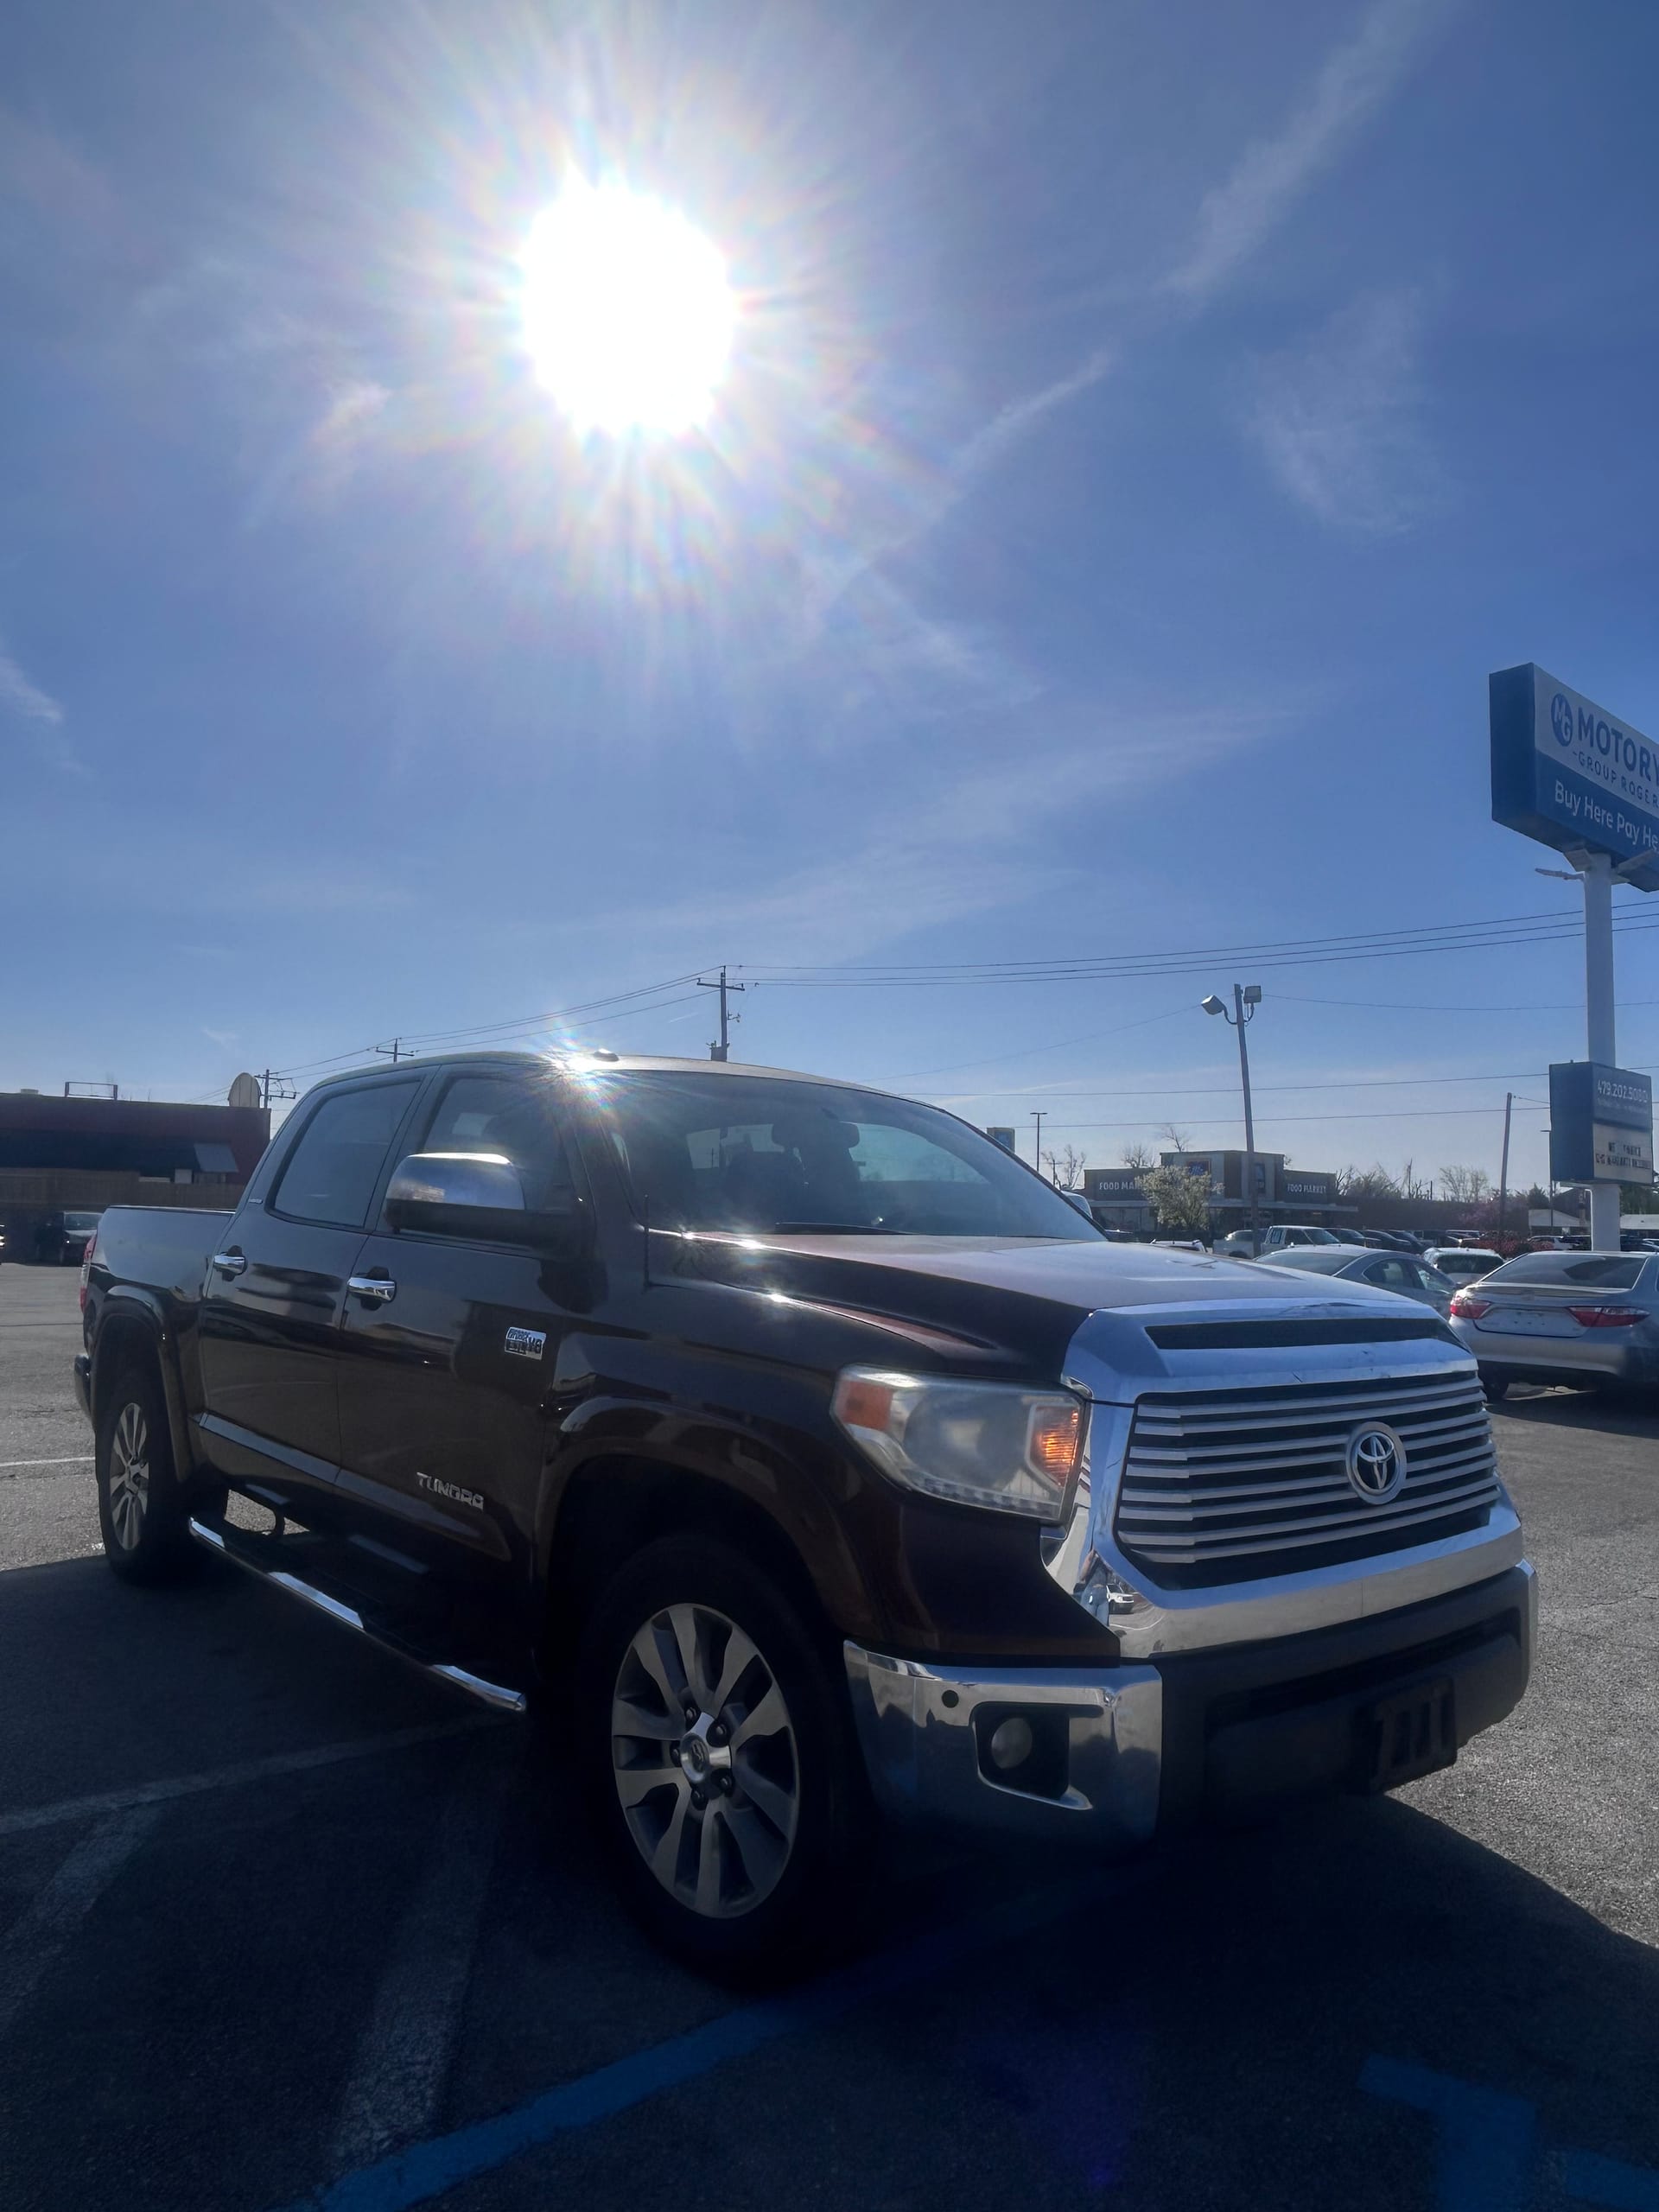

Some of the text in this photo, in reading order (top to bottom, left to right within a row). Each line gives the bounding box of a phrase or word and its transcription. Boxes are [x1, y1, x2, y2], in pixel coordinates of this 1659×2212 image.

[1578, 751, 1659, 809] GROUP ROGER
[1555, 779, 1581, 817] Buy
[1584, 795, 1614, 830] Here
[1617, 811, 1640, 846] Pay
[1099, 1181, 1120, 1190] FOOD
[1287, 1183, 1302, 1192] FOOD
[416, 1471, 484, 1511] TUNDRA
